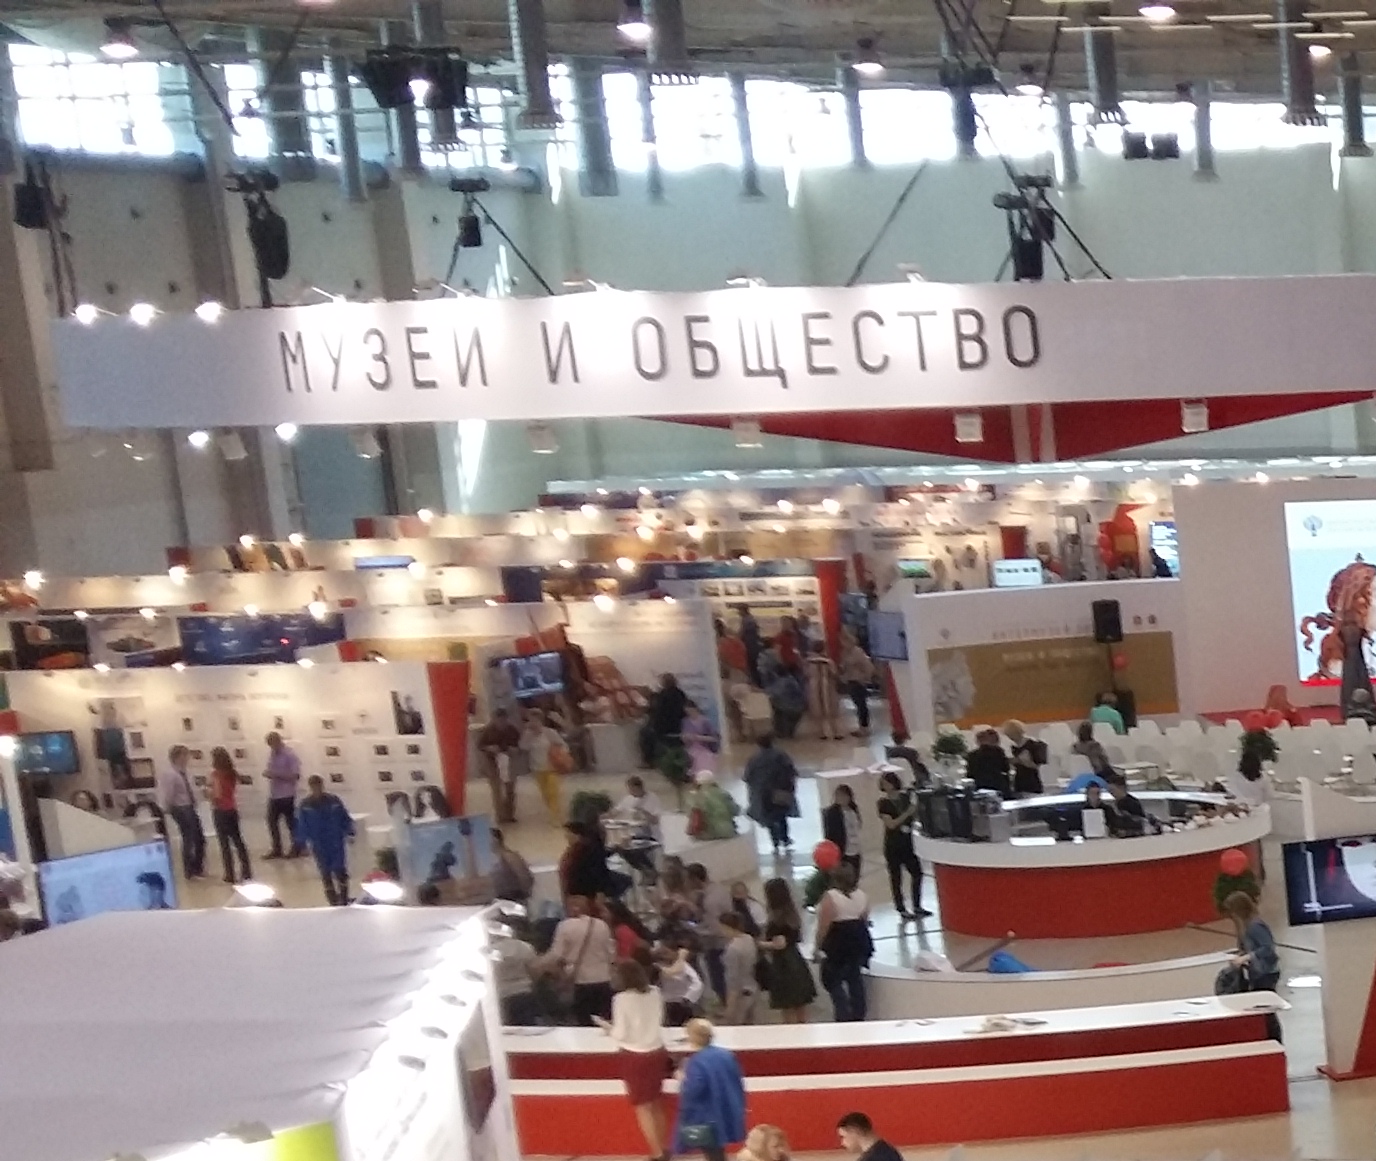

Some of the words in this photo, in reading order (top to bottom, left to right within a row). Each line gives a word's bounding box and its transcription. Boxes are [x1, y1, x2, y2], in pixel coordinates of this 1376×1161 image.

[279, 325, 491, 394] МУЗЕИ
[539, 321, 583, 384] И
[631, 303, 1043, 389] ОБЩЕСТВО
